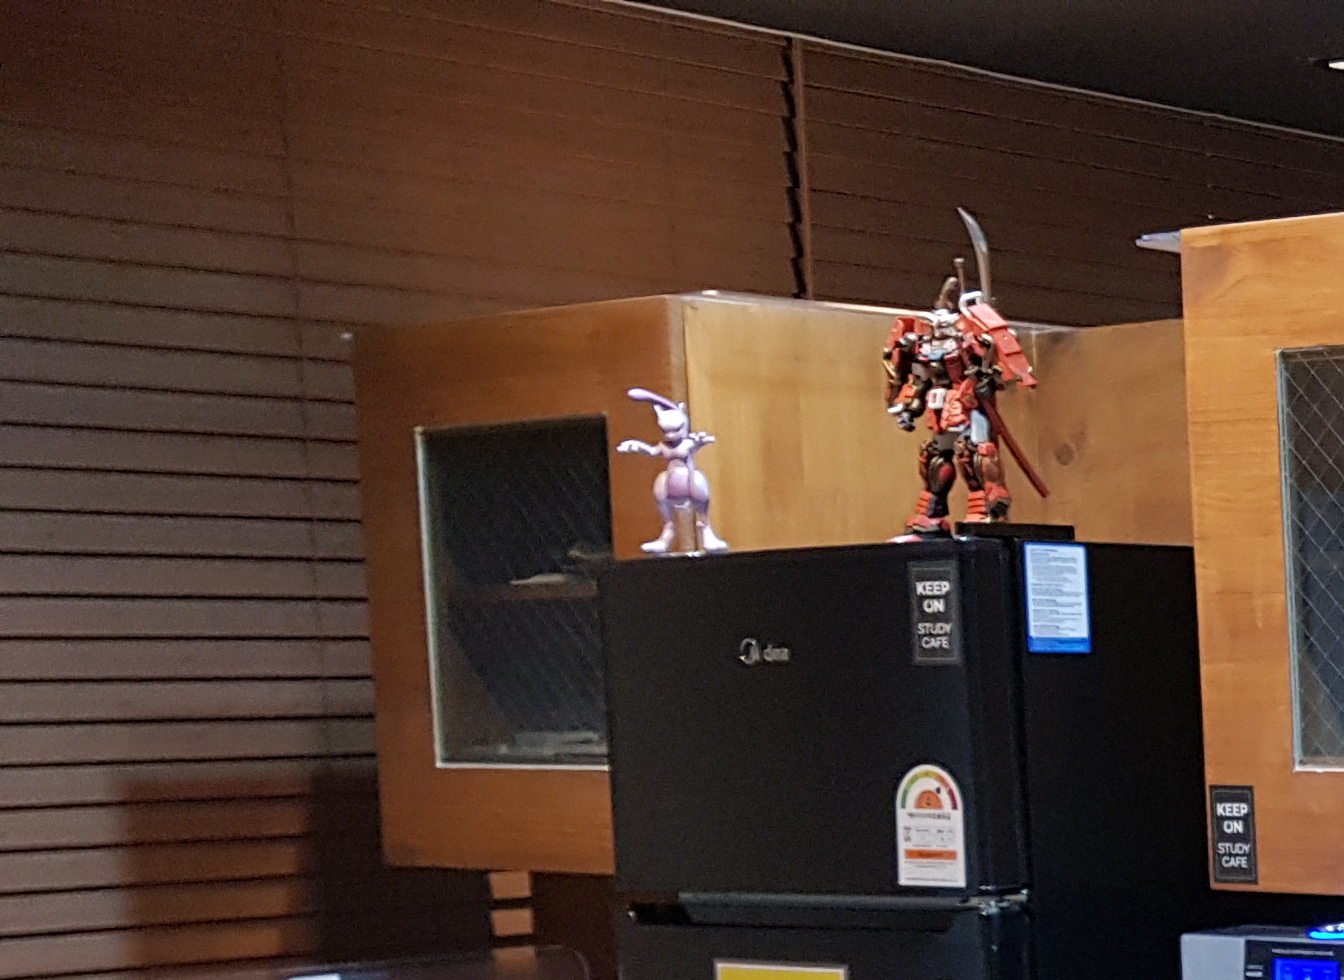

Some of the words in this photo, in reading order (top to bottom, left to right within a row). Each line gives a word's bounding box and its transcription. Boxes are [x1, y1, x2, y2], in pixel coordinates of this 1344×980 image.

[915, 581, 950, 596] KEEP
[923, 599, 945, 613] ON
[917, 623, 952, 636] STUDY
[921, 637, 950, 650] CAFE
[1216, 802, 1248, 816] KEEP
[1223, 820, 1243, 833] ON
[1217, 842, 1251, 855] STUDY
[1221, 856, 1249, 868] CAFE
